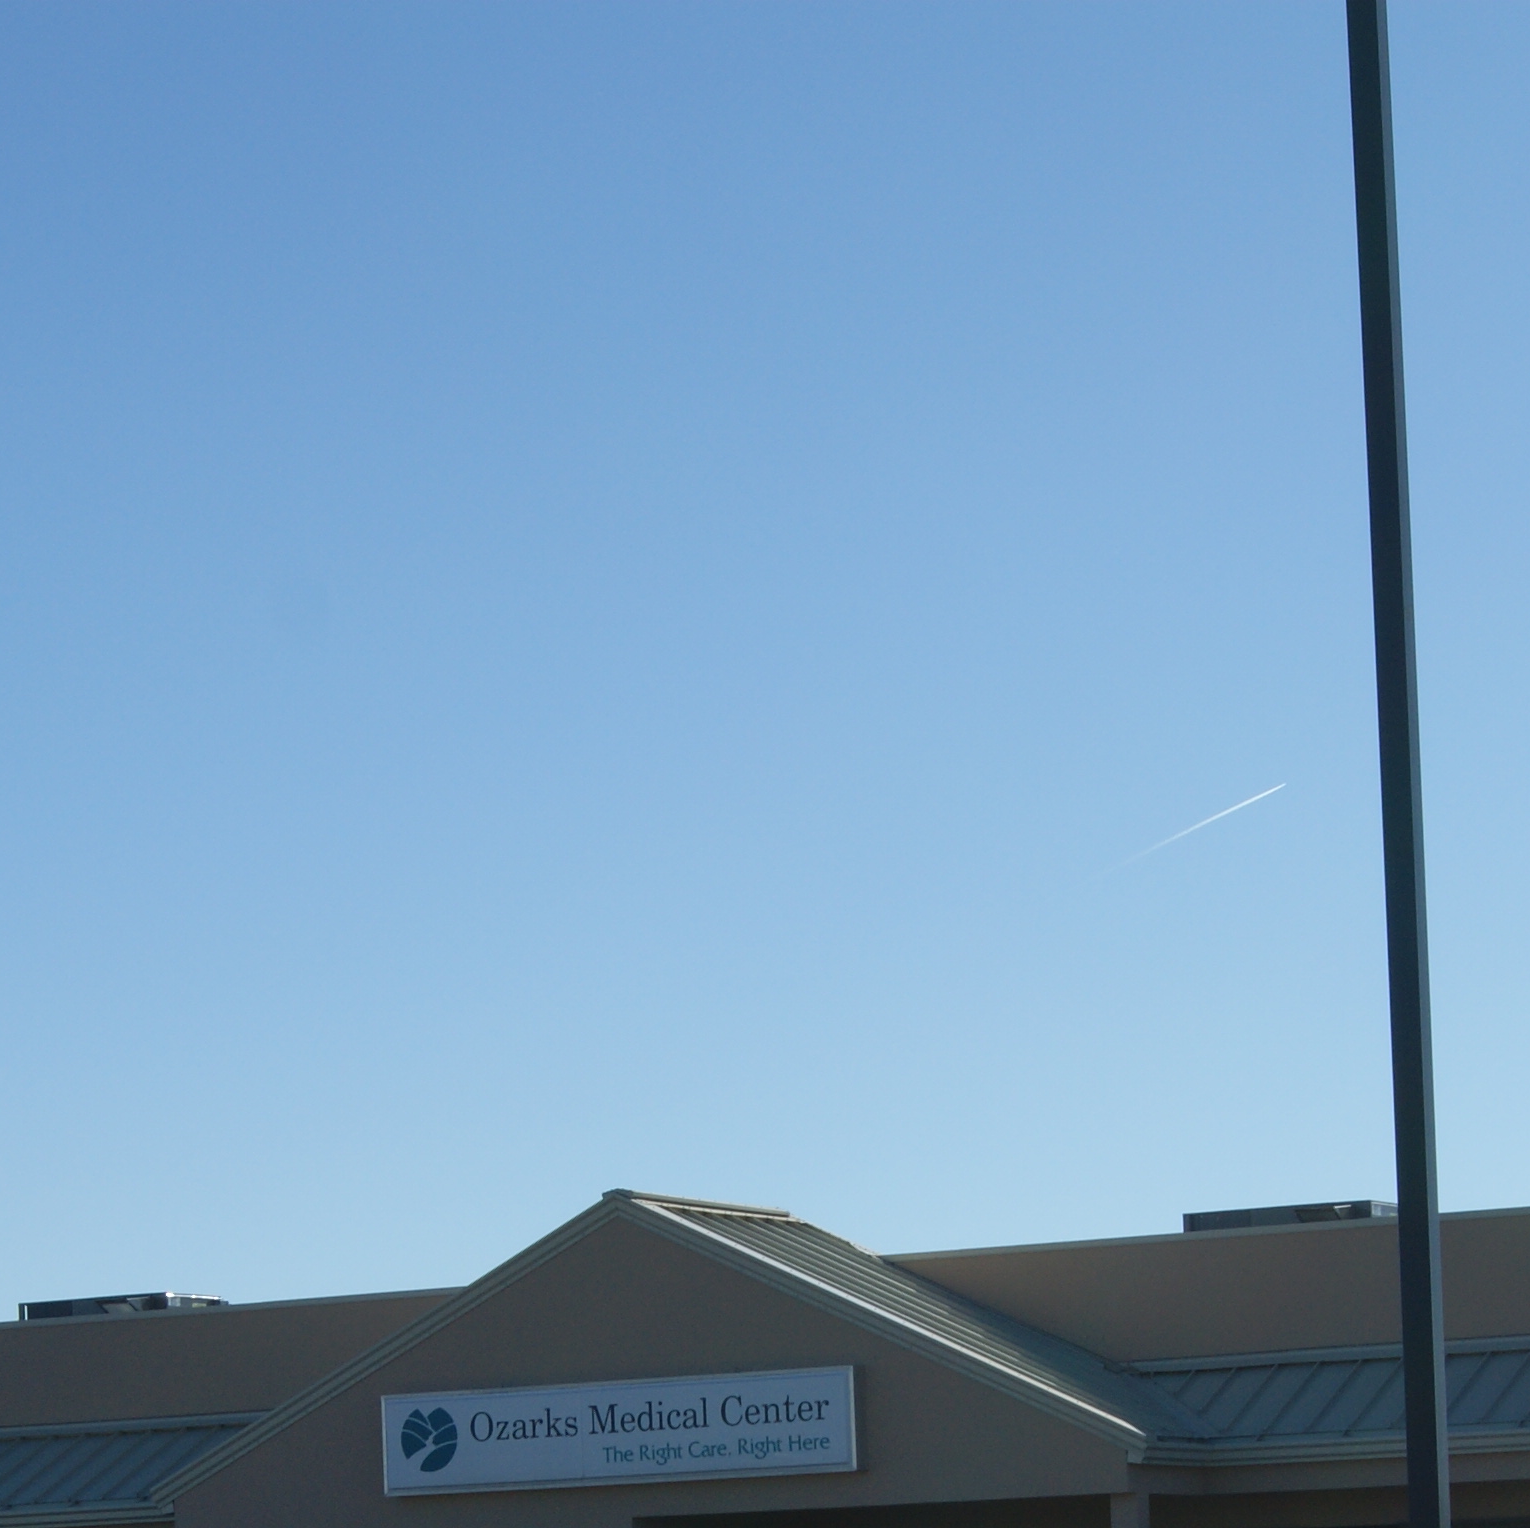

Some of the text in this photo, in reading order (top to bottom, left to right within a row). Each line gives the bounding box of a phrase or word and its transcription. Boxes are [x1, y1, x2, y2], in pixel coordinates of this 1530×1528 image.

[470, 1394, 830, 1442] Ozarks Medical Center
[601, 1446, 634, 1464] The
[639, 1441, 683, 1465] Right
[737, 1436, 782, 1460] Right
[788, 1435, 831, 1452] Here
